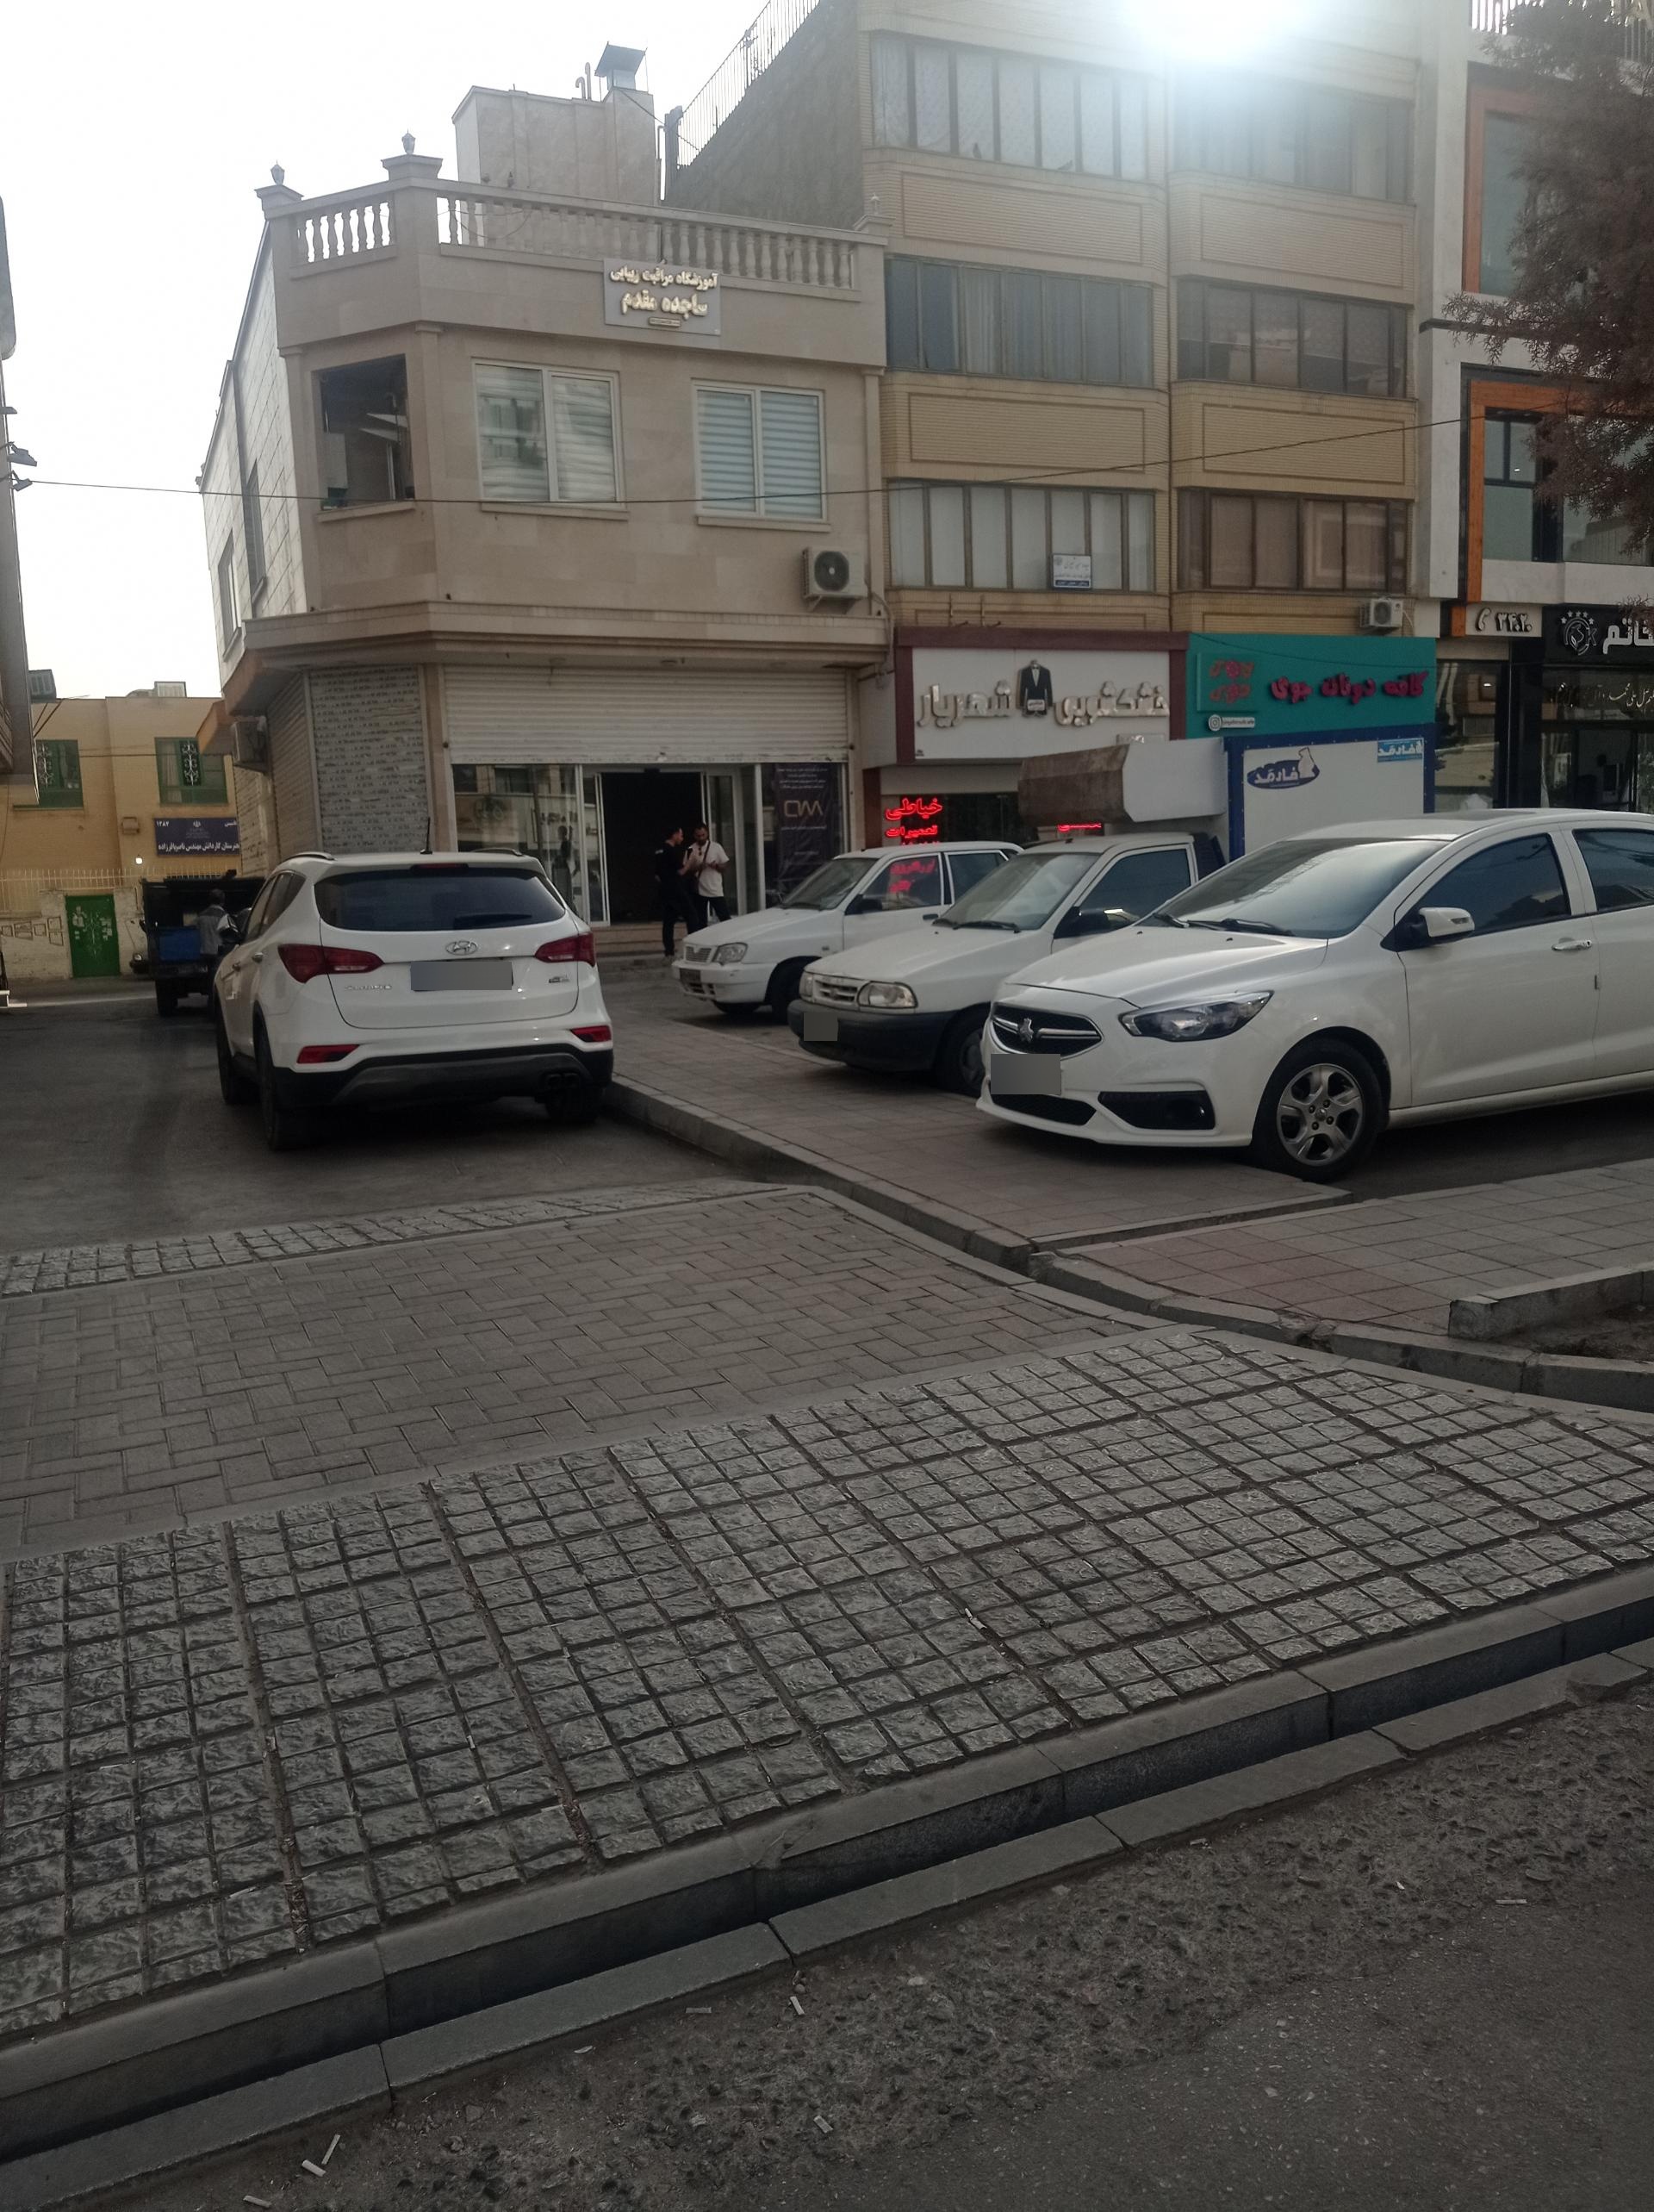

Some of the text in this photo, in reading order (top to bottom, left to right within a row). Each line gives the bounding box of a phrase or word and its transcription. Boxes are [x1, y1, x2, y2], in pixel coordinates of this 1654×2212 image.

[642, 267, 674, 287] مراقبت
[675, 271, 718, 290] آموزشگاه
[621, 290, 708, 320] ساجده مقدم
[1384, 670, 1429, 697] کافه
[916, 680, 1011, 728] شهریار
[885, 797, 943, 820] خیاطی
[885, 825, 938, 839] تعمیرات
